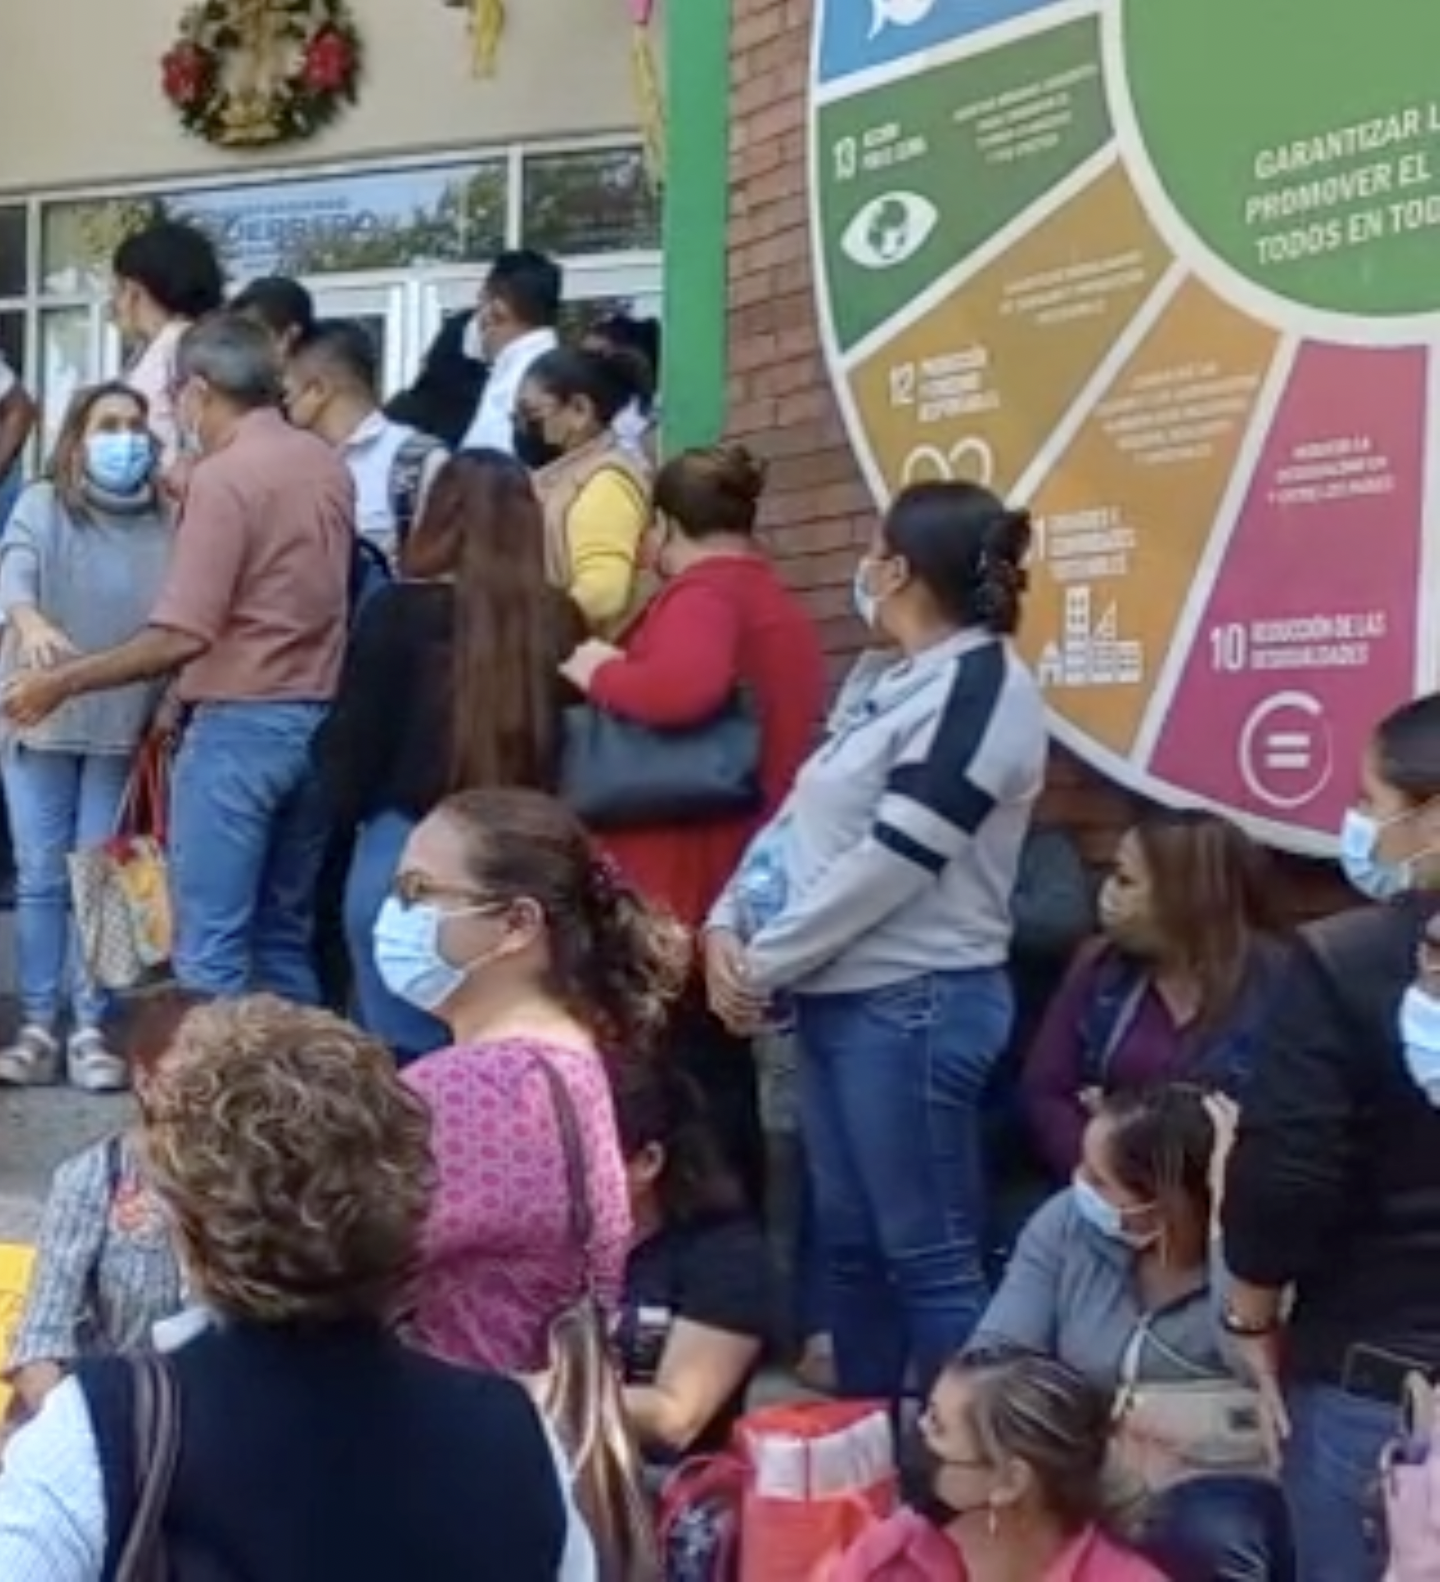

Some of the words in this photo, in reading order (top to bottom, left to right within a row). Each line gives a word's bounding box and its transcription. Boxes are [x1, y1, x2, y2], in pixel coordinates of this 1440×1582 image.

[1254, 109, 1419, 180] GARANTIZAR
[1245, 164, 1392, 225] PROMOVER
[1398, 152, 1433, 188] EL
[1254, 218, 1342, 265] TODOS
[1348, 208, 1383, 245] EN
[1210, 622, 1246, 671] 10
